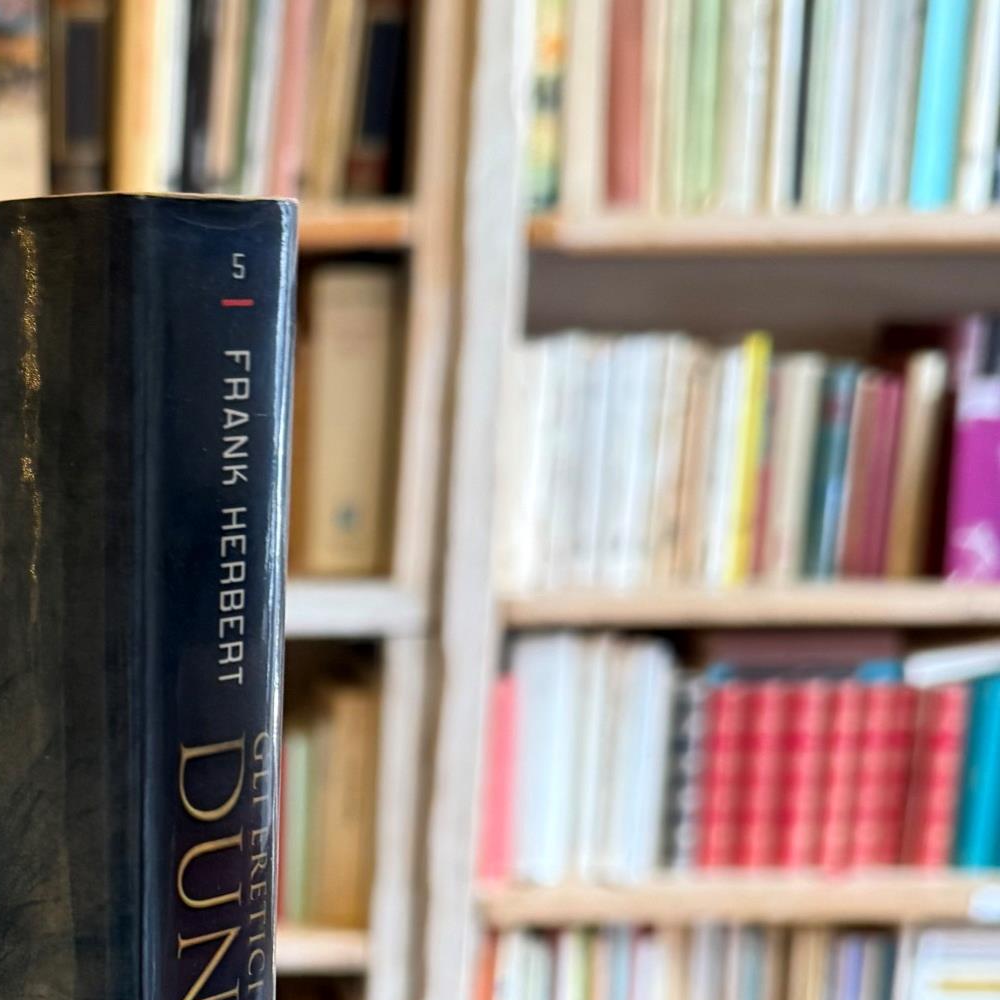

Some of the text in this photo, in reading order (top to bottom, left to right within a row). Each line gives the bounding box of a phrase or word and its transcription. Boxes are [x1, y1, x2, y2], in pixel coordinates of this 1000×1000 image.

[231, 253, 247, 280] 5
[216, 349, 251, 686] FRANK HERBERT
[252, 732, 270, 804] GLI
[246, 827, 270, 993] ERETICI
